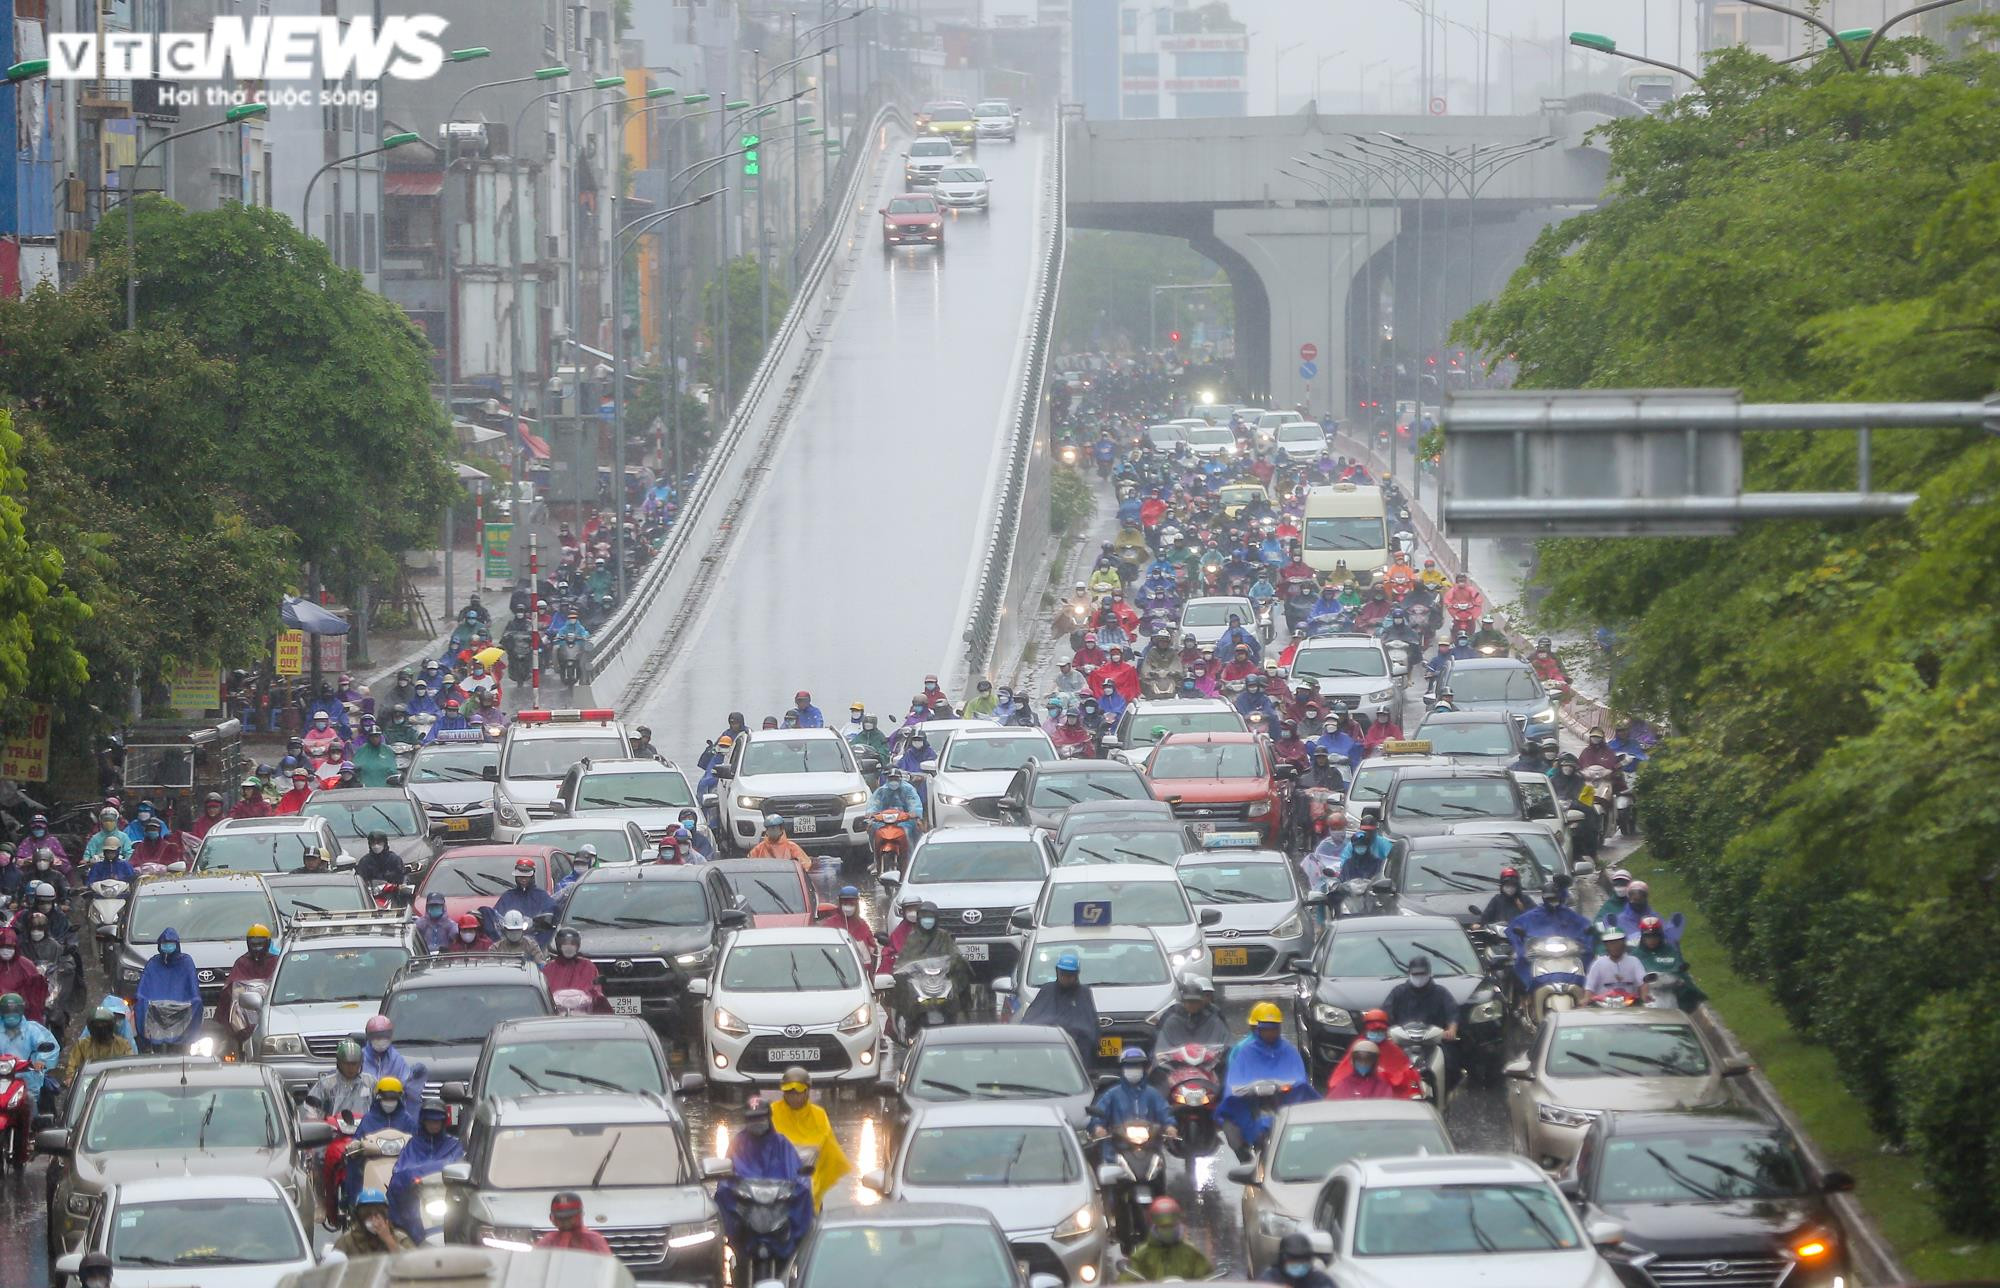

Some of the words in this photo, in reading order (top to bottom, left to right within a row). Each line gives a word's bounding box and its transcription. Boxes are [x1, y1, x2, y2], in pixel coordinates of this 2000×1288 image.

[280, 646, 298, 655] KIM
[1083, 904, 1103, 923] G7
[613, 1006, 638, 1014] 25.56
